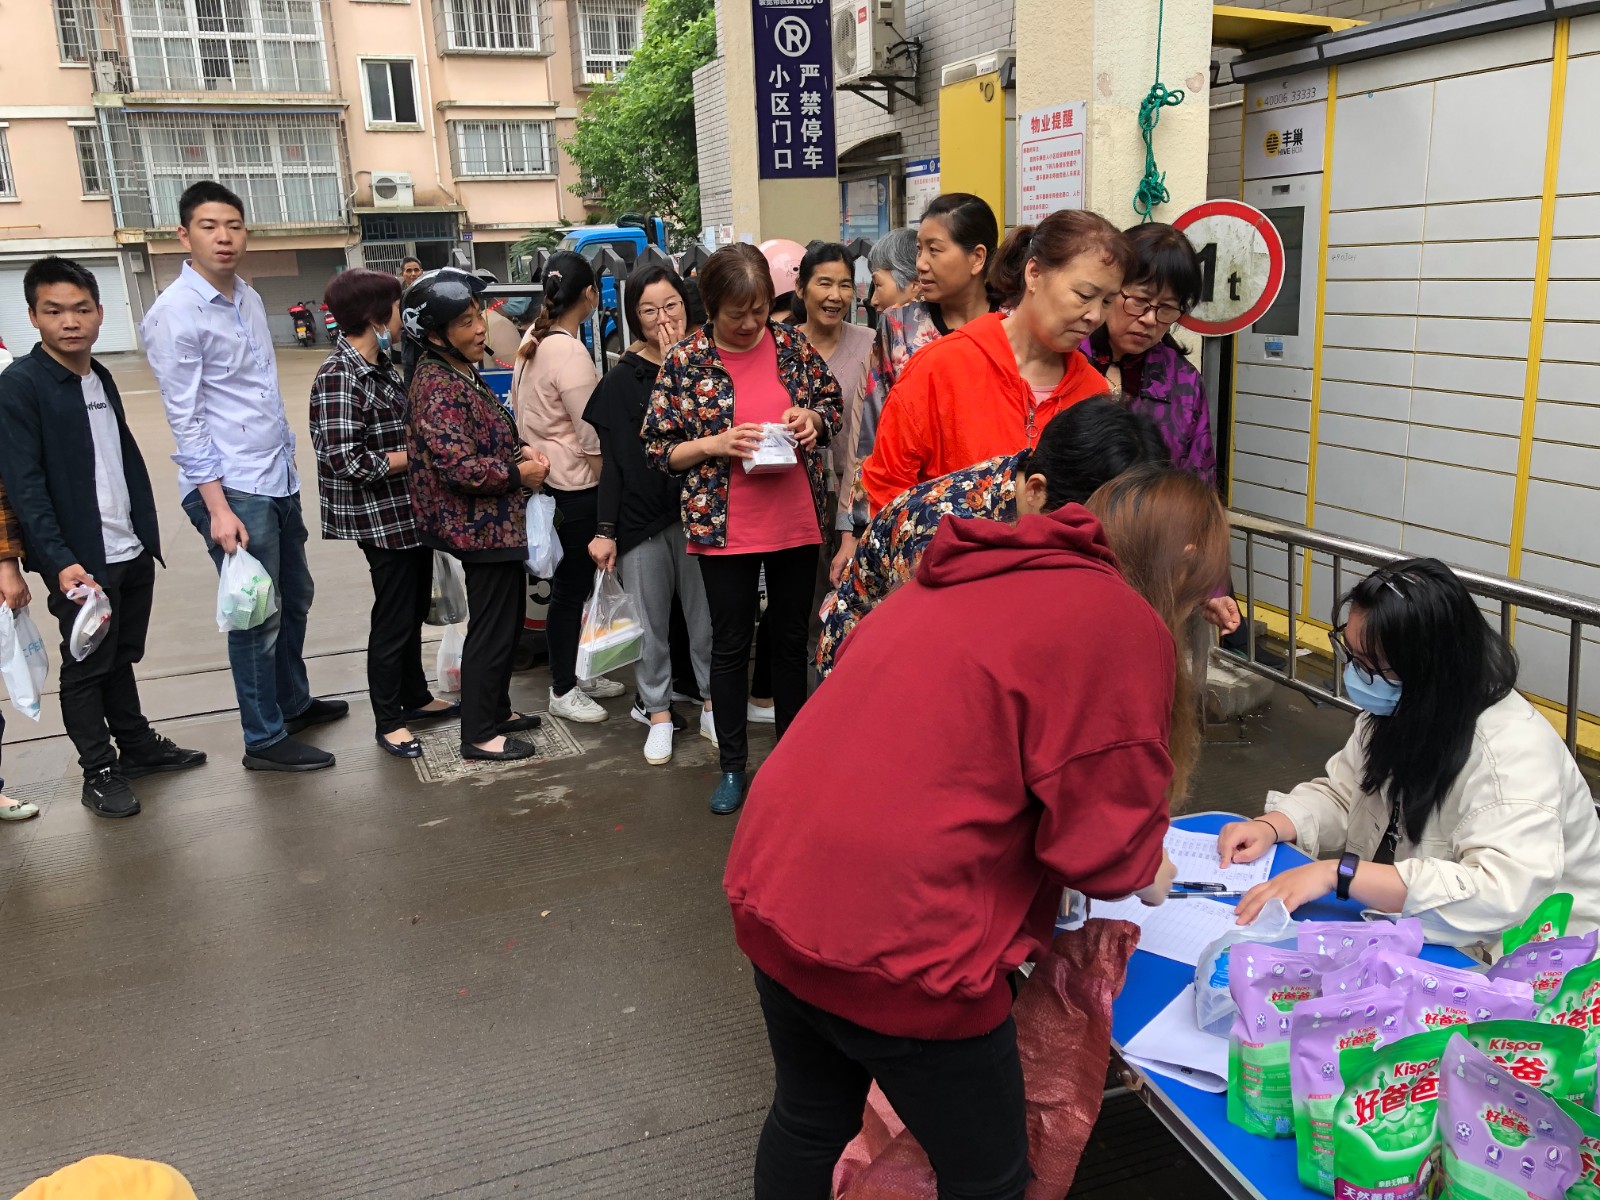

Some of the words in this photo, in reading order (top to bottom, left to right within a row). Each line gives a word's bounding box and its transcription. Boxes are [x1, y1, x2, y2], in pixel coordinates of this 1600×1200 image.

[1264, 92, 1288, 106] 40006
[1291, 86, 1317, 102] 33333
[768, 63, 793, 170] 小区门口
[799, 63, 824, 170] 严禁停车
[1030, 109, 1073, 135] 物业提醒
[1281, 127, 1304, 147] 丰巢
[1277, 147, 1291, 156] HIVE
[1445, 1007, 1467, 1015] Kispa
[1489, 1039, 1542, 1053] Kispa
[1394, 1058, 1439, 1078] Kispa
[1354, 1070, 1440, 1127] 好爸爸
[1485, 1109, 1530, 1136] 好爸爸
